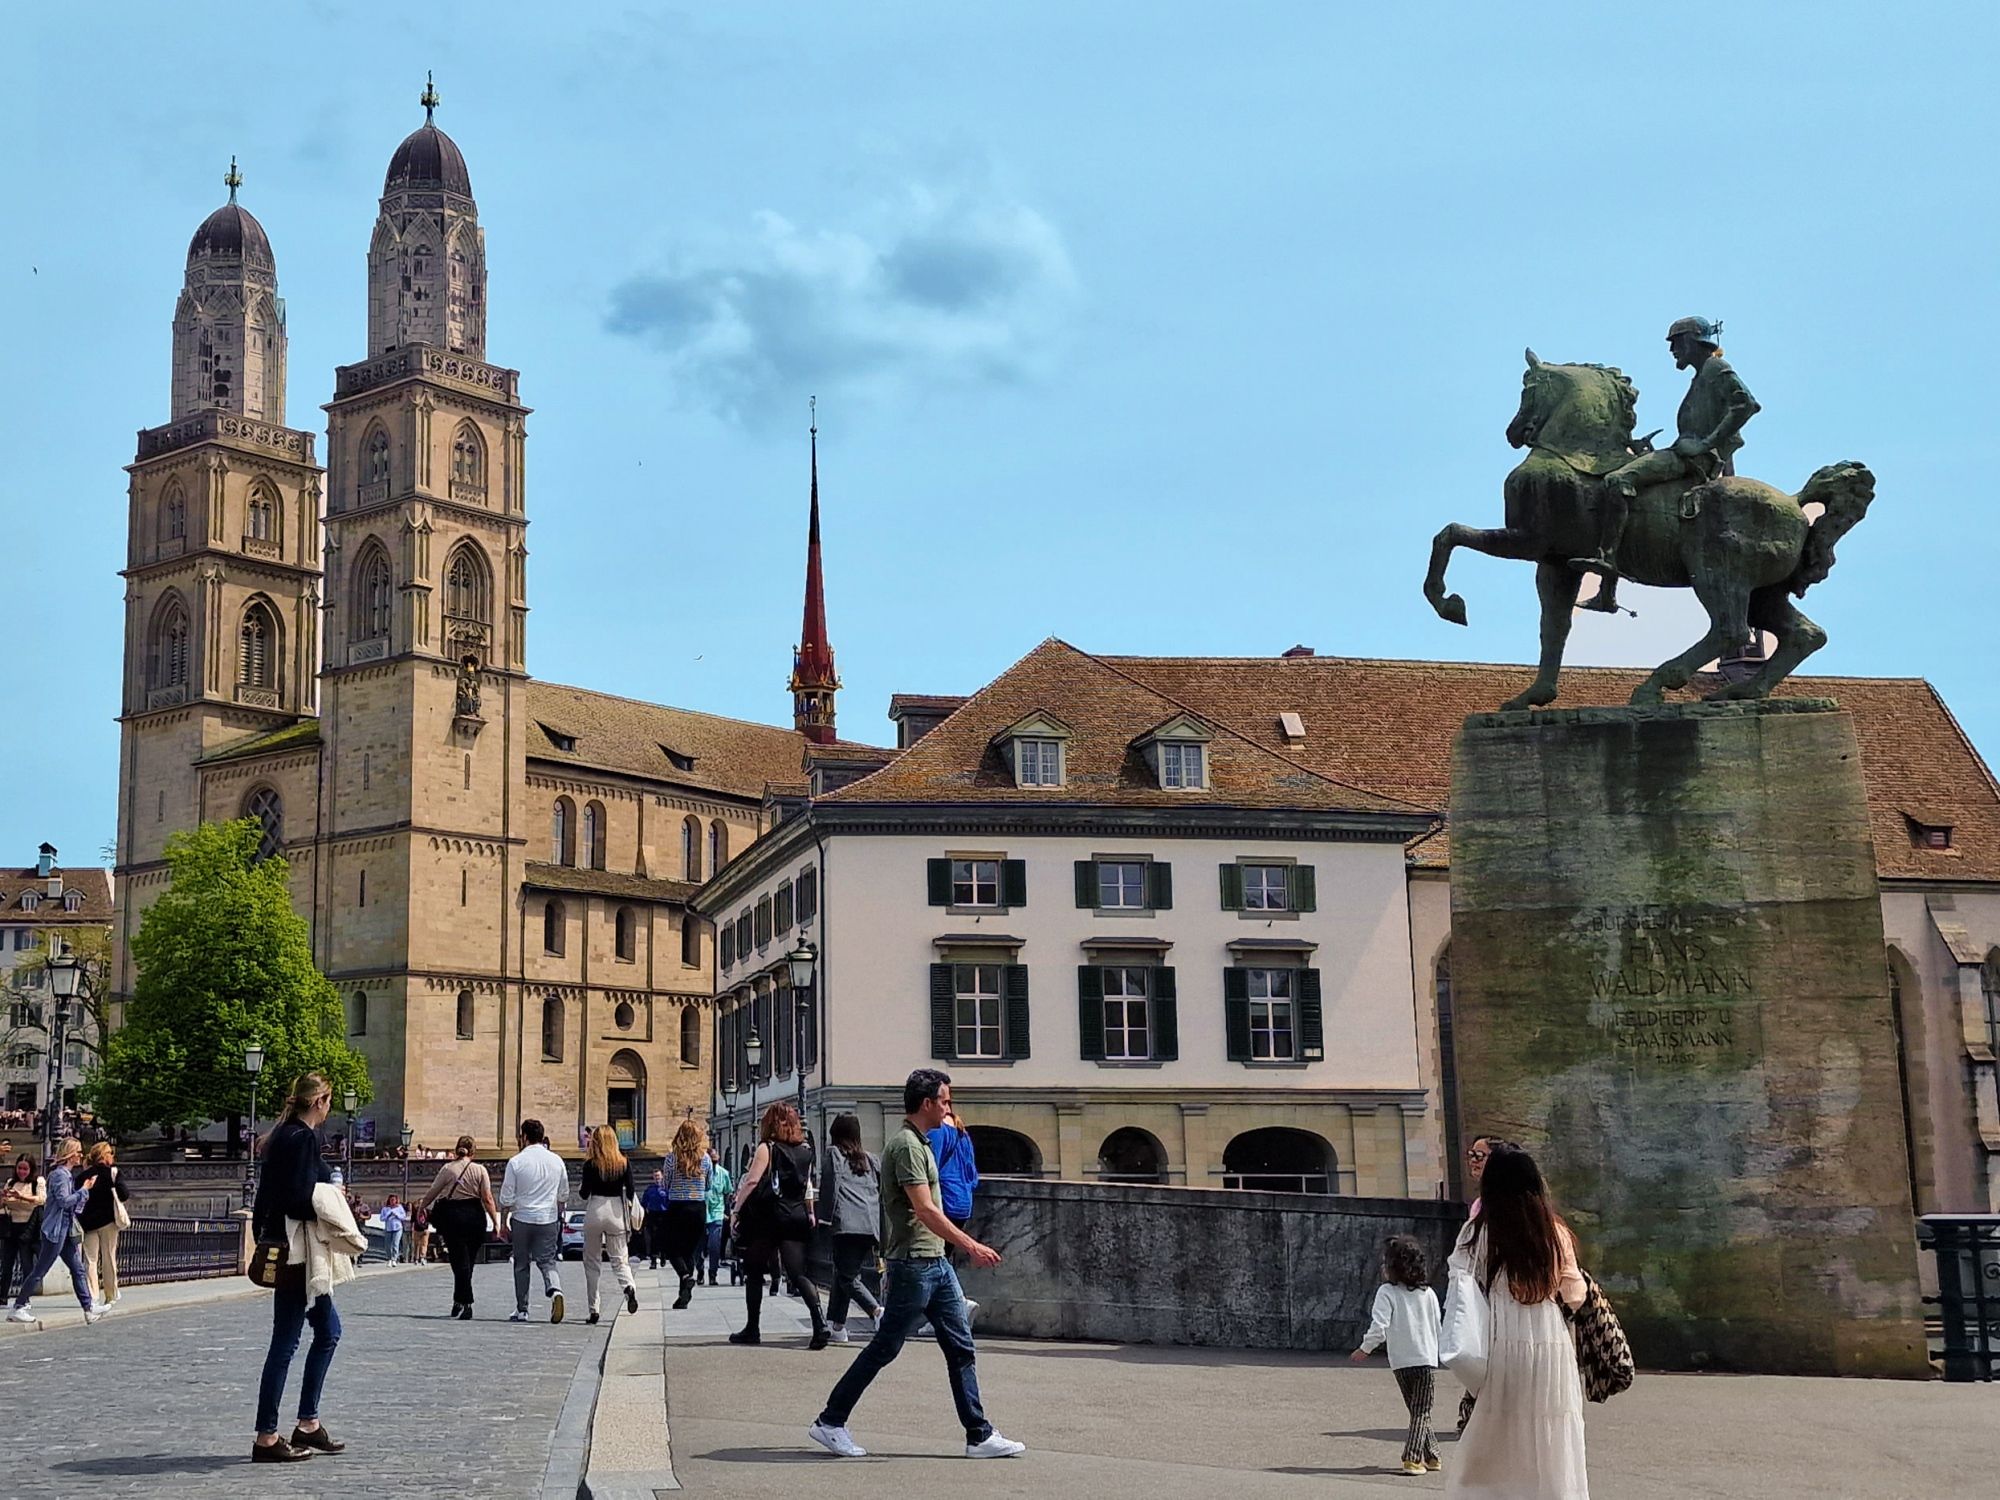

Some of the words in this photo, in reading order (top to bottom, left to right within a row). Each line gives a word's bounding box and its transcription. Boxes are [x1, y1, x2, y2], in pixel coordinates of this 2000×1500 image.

[1628, 934, 1705, 963] HANS
[1587, 967, 1752, 997] WALDMANN
[1617, 1032, 1732, 1047] STAATSMANN
